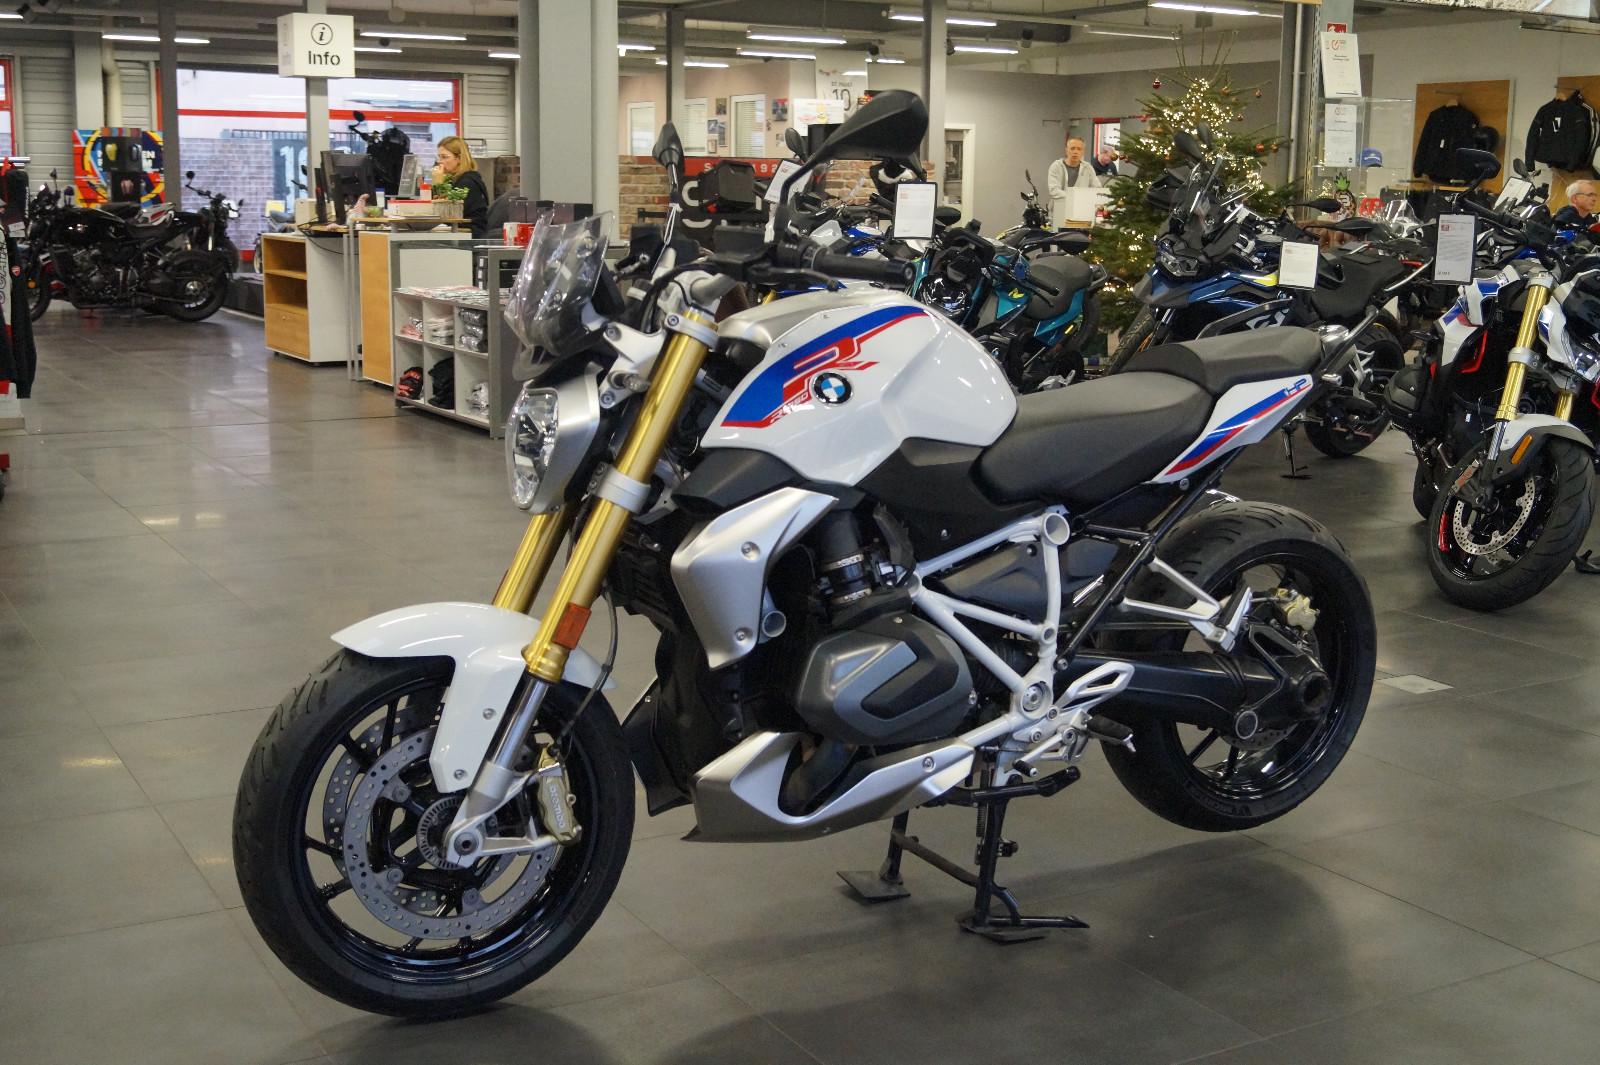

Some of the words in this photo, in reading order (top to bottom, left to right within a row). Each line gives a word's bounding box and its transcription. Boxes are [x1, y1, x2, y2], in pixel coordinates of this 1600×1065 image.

[308, 50, 341, 66] Info
[1284, 378, 1307, 398] HP
[549, 784, 566, 828] brembo
